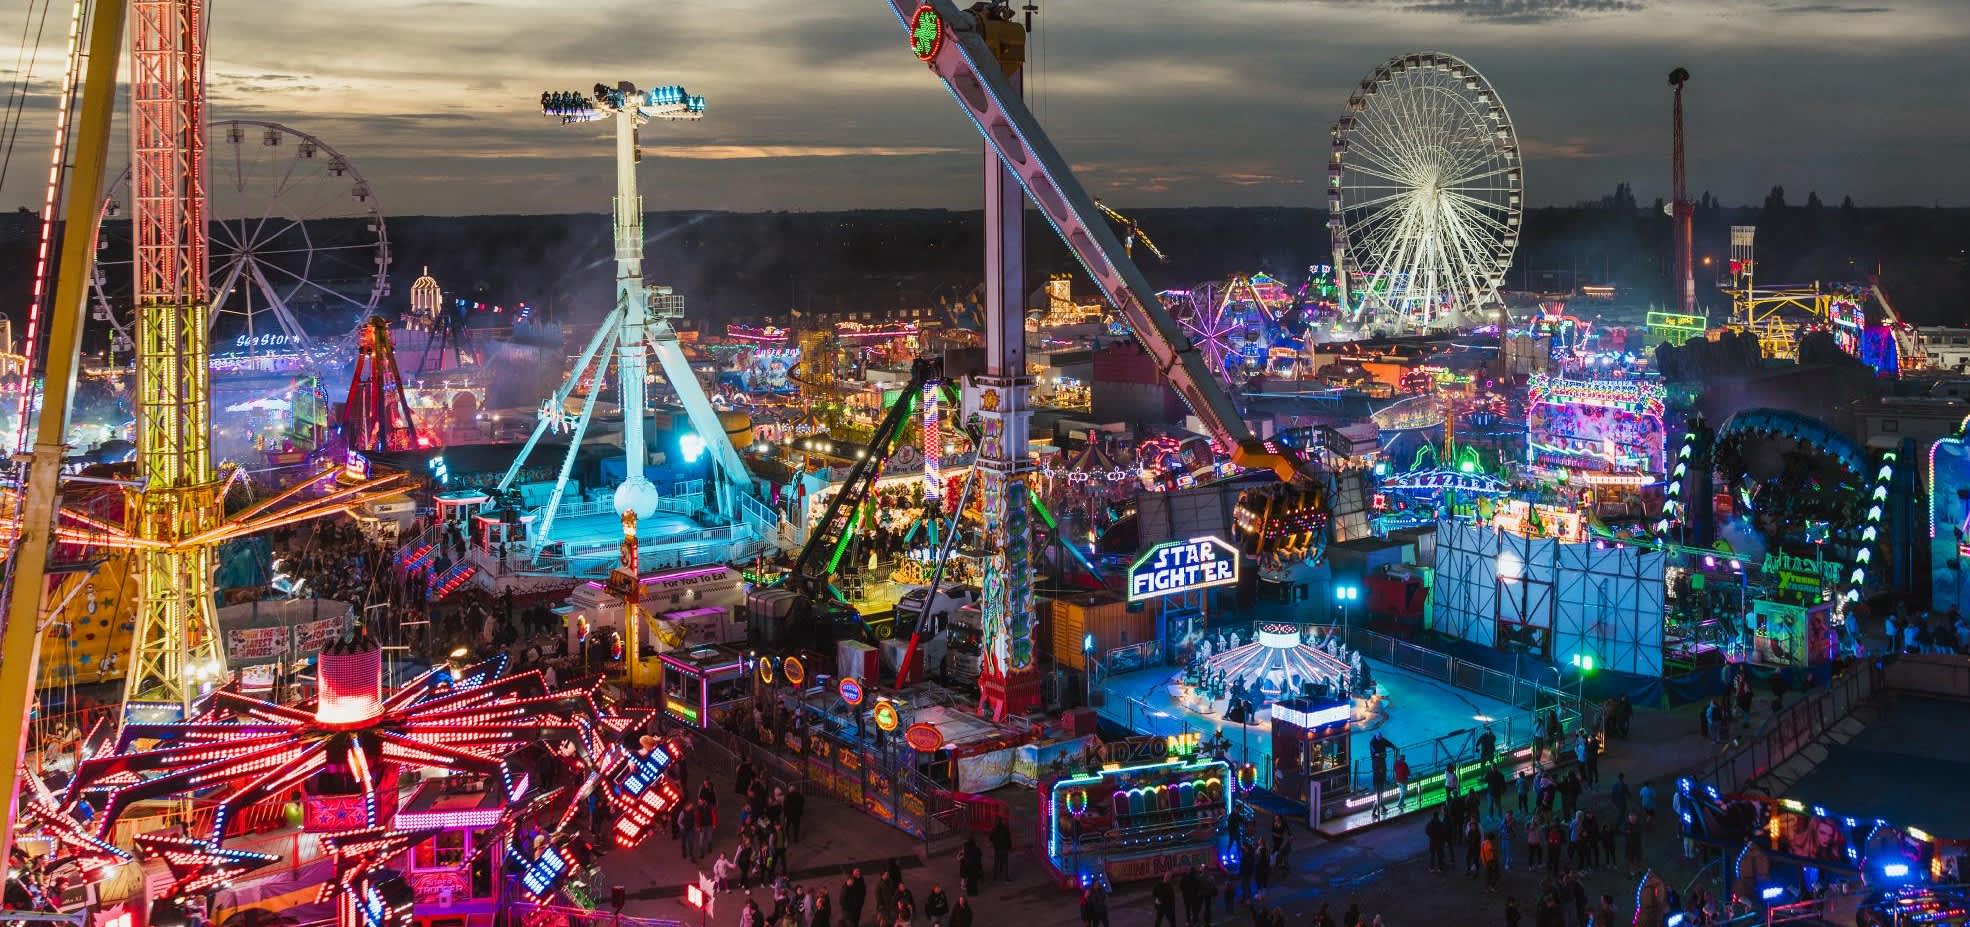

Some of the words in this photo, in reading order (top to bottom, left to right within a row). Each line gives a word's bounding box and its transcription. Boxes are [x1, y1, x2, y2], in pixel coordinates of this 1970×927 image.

[1399, 474, 1496, 491] SIZZLER
[1154, 542, 1216, 569] STAR
[680, 577, 697, 585] You
[711, 572, 727, 580] Eat
[1133, 560, 1233, 594] FIGHTER
[246, 647, 272, 657] PRIZES
